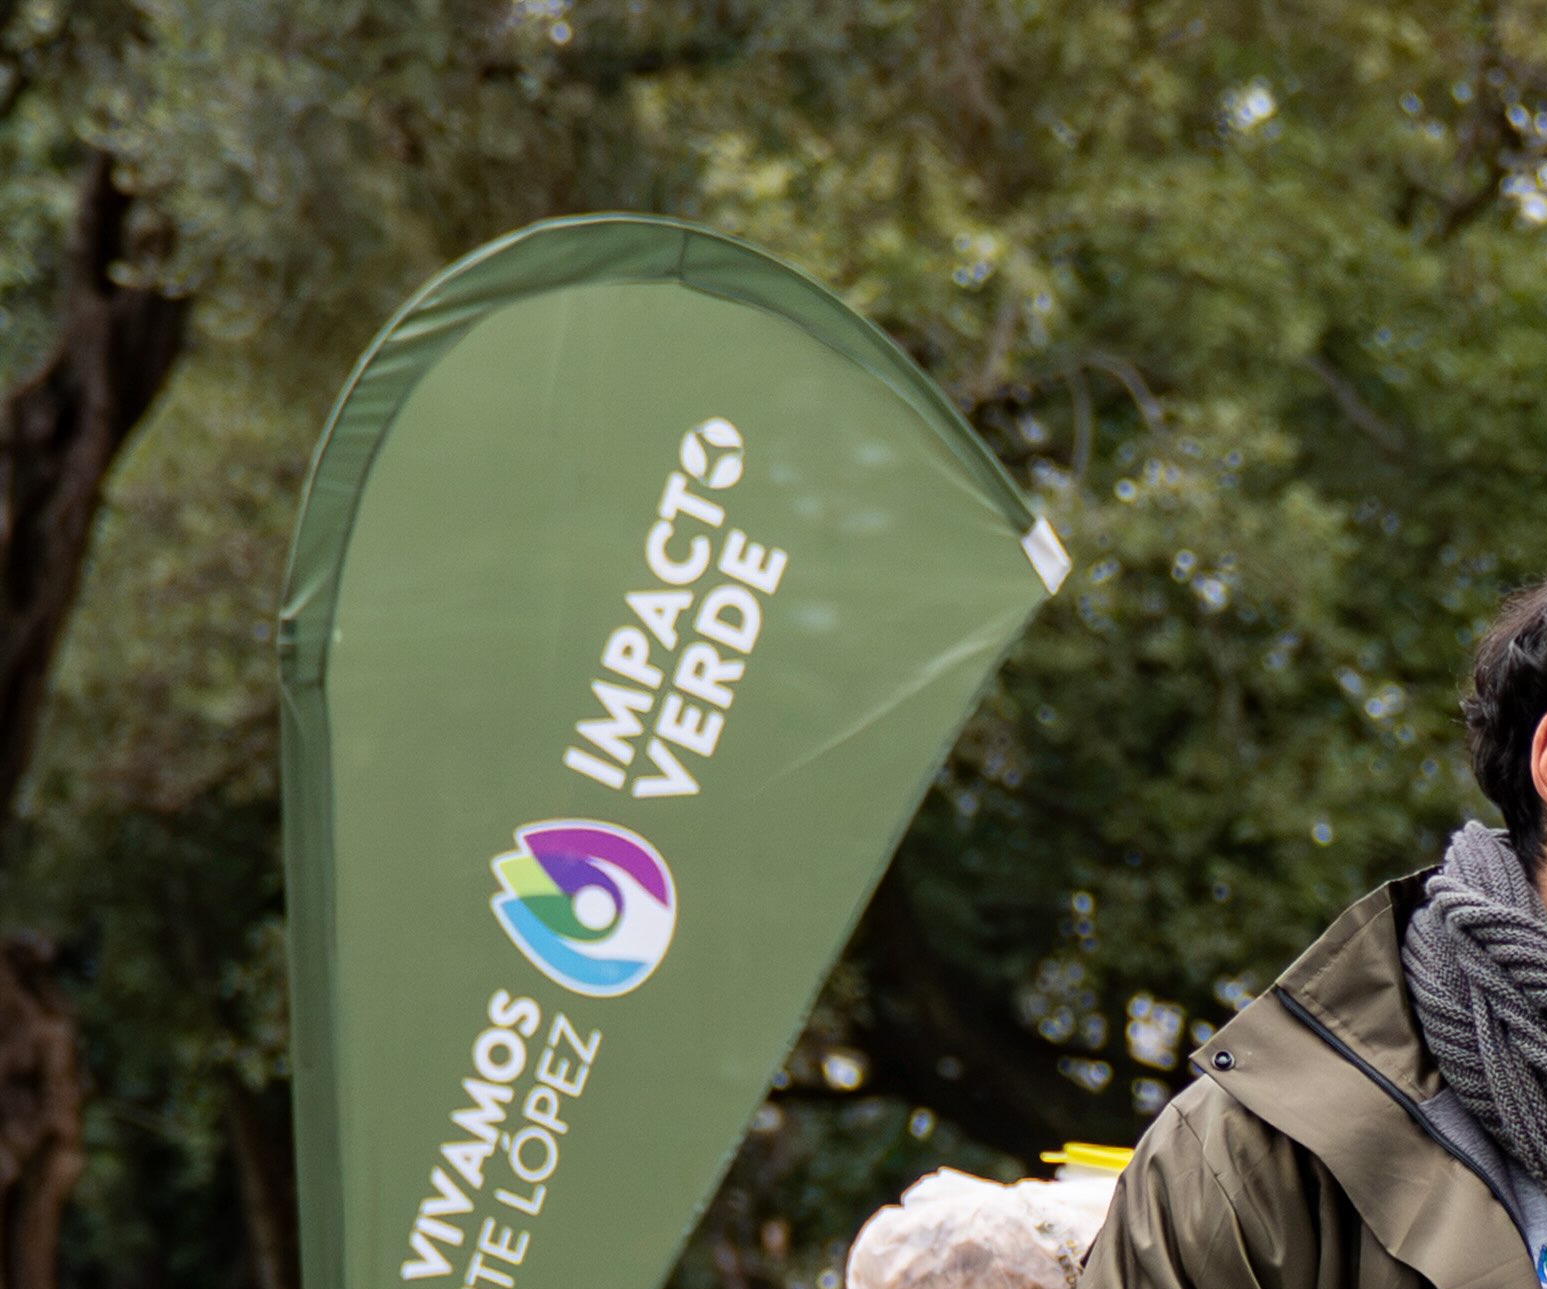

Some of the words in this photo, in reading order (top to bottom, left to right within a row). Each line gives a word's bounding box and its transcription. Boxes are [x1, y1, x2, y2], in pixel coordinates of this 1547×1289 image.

[564, 415, 744, 790] IMPACTO
[632, 529, 788, 799] VERDE
[400, 989, 542, 1281] VIVAMOS
[495, 1012, 601, 1216] LÓPEZ
